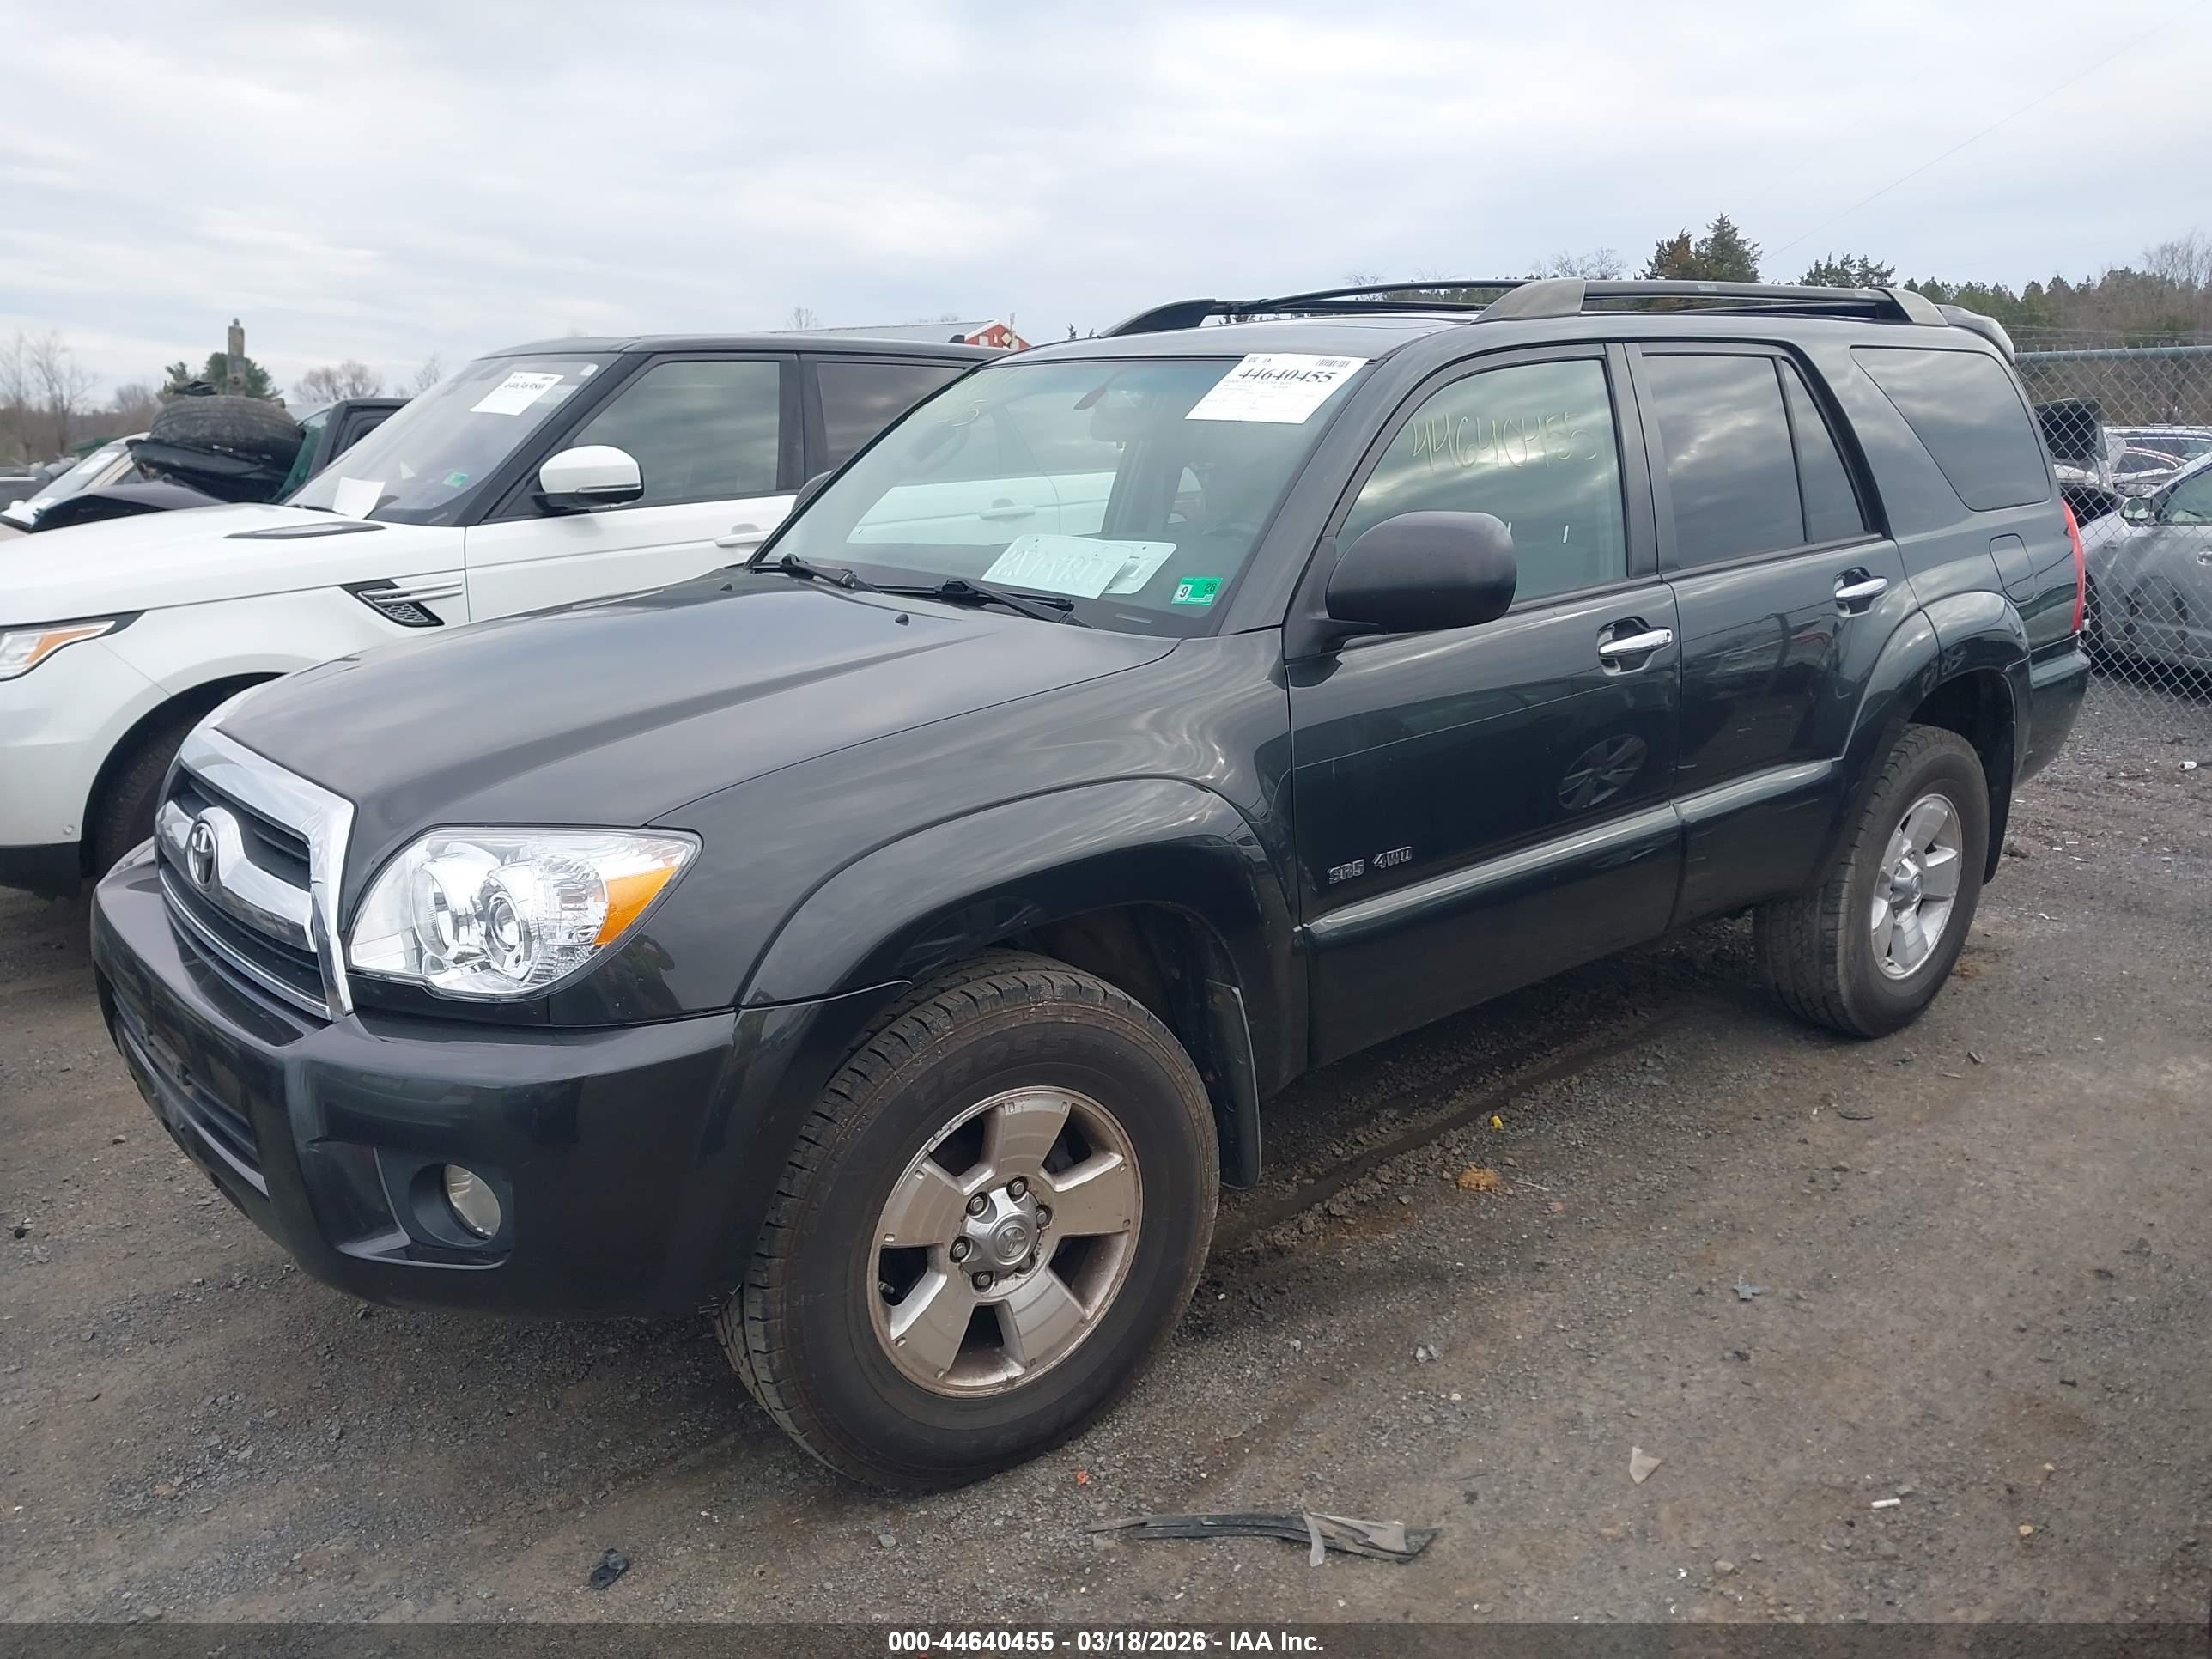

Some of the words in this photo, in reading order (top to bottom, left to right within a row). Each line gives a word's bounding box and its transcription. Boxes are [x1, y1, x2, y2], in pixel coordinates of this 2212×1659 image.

[1238, 368, 1338, 384] 44640455
[1412, 411, 1598, 473] 44640455
[1180, 586, 1189, 598] 9
[1204, 583, 1217, 592] 26
[1327, 859, 1365, 884] SR5
[1373, 846, 1413, 869] 4WD
